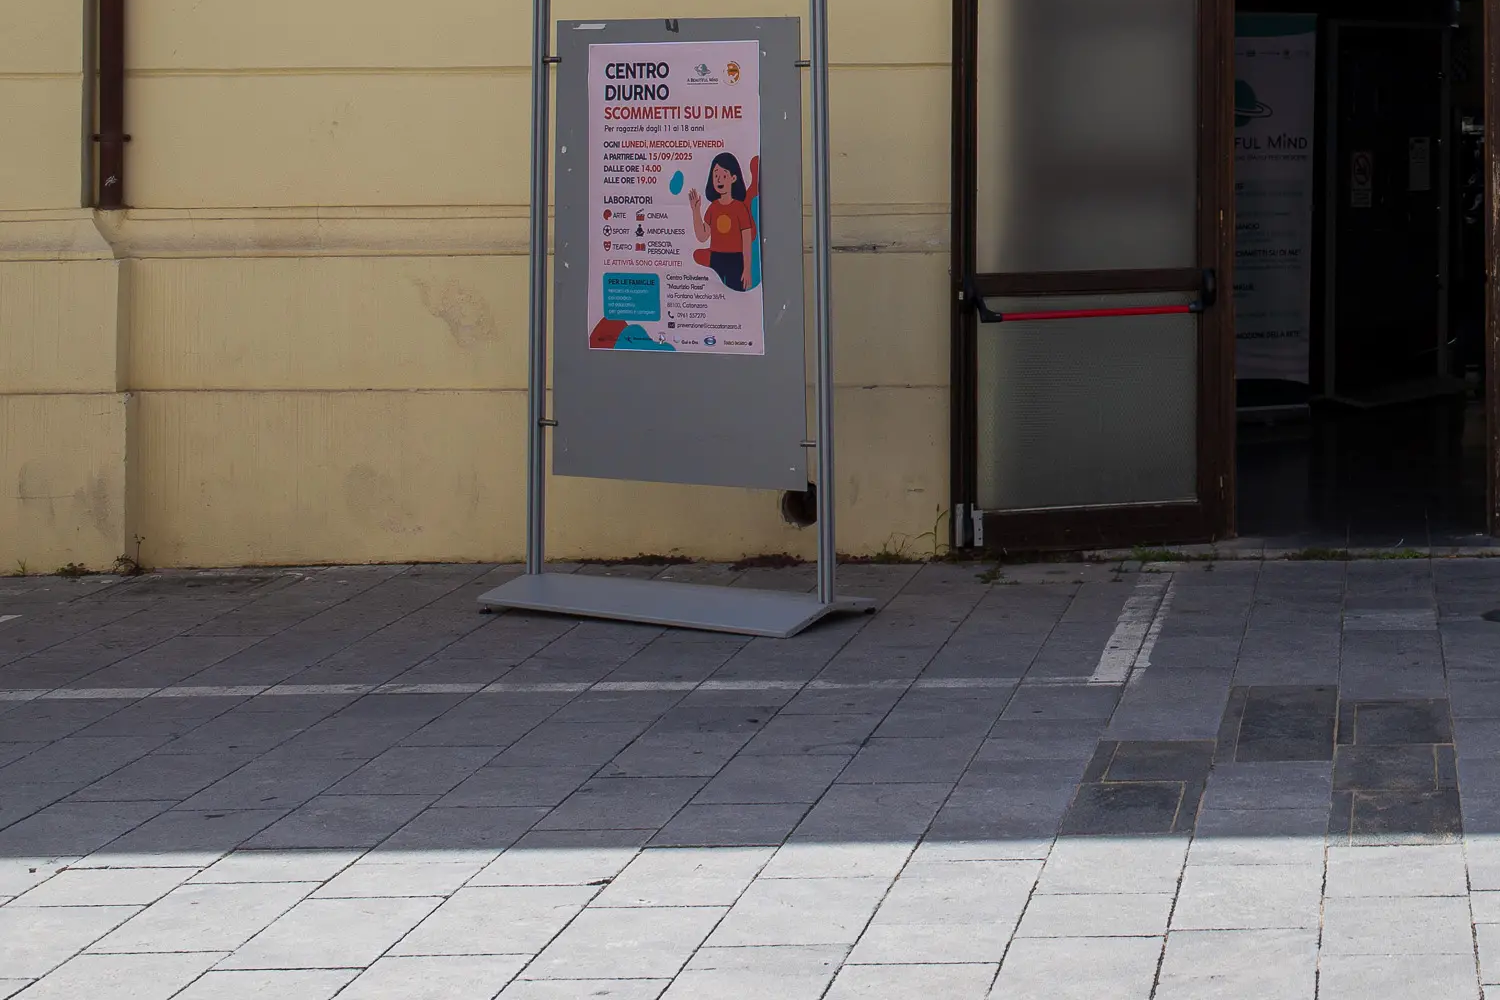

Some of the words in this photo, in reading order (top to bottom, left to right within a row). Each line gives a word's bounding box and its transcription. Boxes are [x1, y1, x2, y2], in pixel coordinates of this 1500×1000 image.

[605, 62, 670, 79] CENTRO
[605, 84, 670, 101] DIURNO
[604, 107, 681, 120] SCOMMETTI
[684, 106, 701, 119] SU
[705, 106, 718, 119] DI
[722, 105, 742, 119] ME
[646, 125, 661, 133] dagli
[609, 153, 634, 161] PARTIRE
[635, 153, 647, 161] DAL
[649, 153, 693, 161] 15/09/2025
[603, 196, 653, 205] LABORATORI
